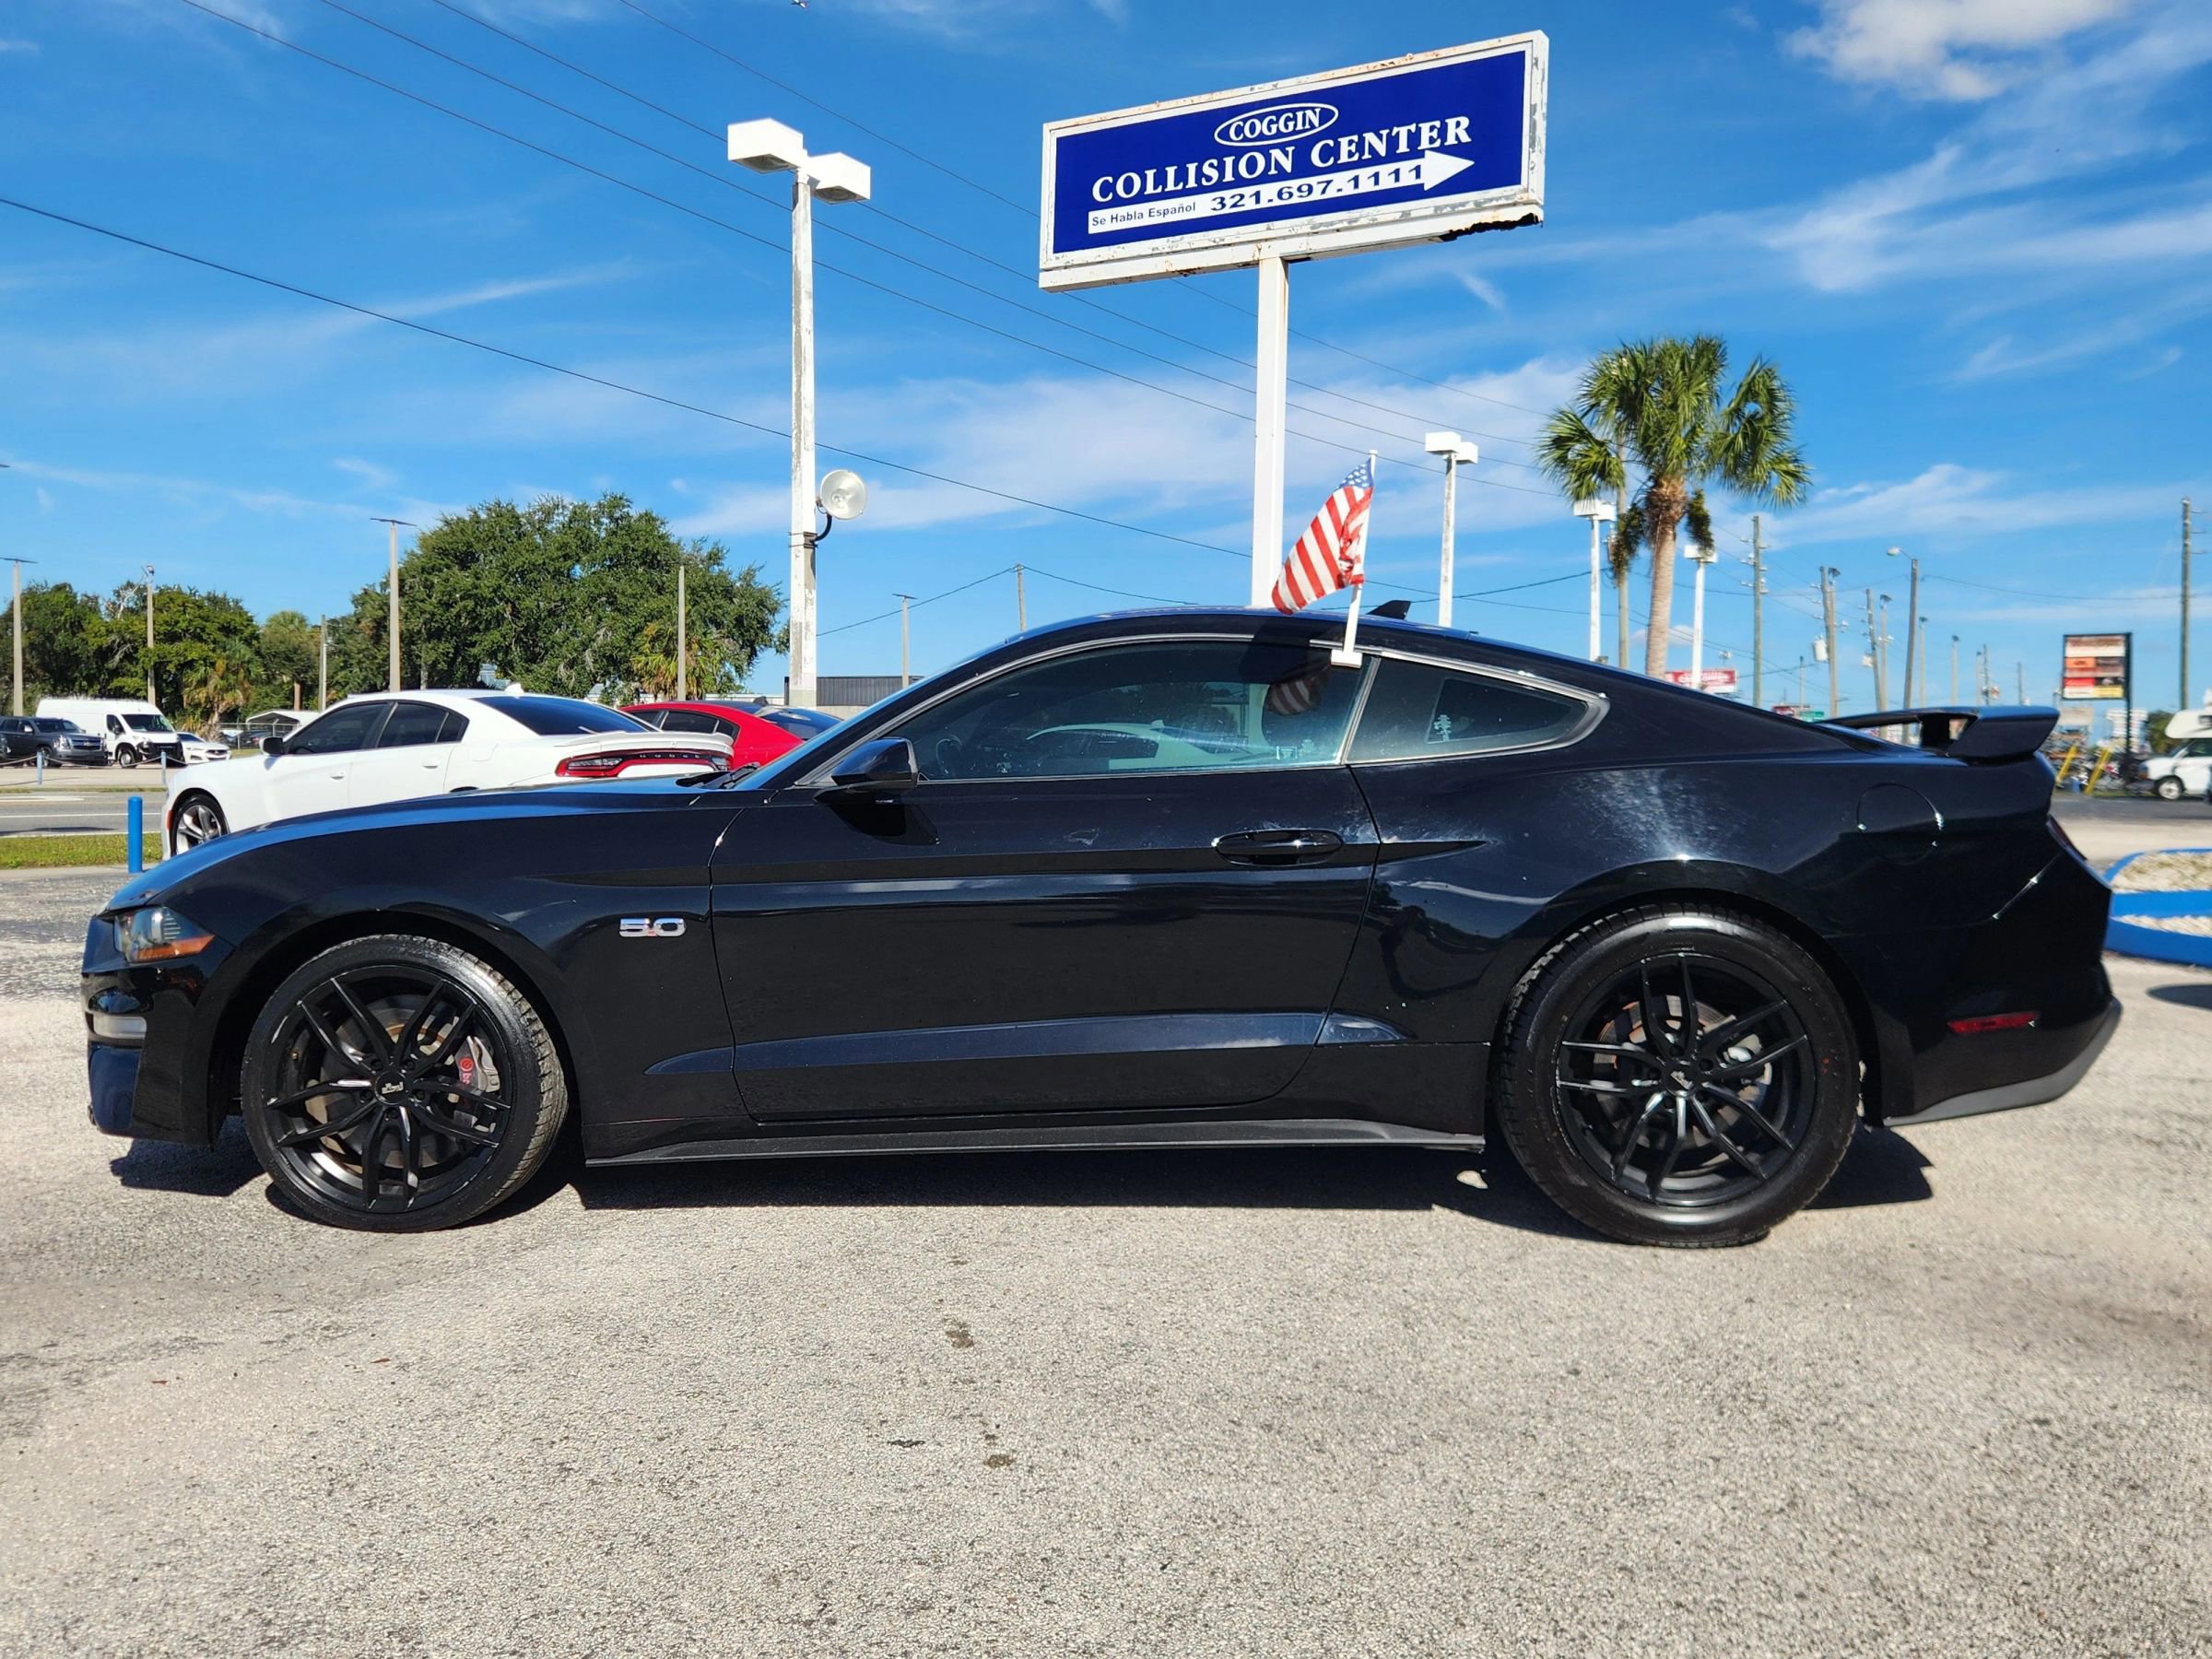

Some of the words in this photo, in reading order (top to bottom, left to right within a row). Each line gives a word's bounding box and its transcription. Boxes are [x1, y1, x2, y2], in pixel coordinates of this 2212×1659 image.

[1230, 108, 1322, 141] COGGIN
[1092, 147, 1295, 202] COLLISION
[1311, 116, 1472, 168] CENTER
[1210, 164, 1422, 211] 321.697.1111
[1092, 216, 1106, 227] Se
[1110, 211, 1144, 224] Habla
[1148, 202, 1196, 218] Español
[618, 917, 687, 937] 5.0
